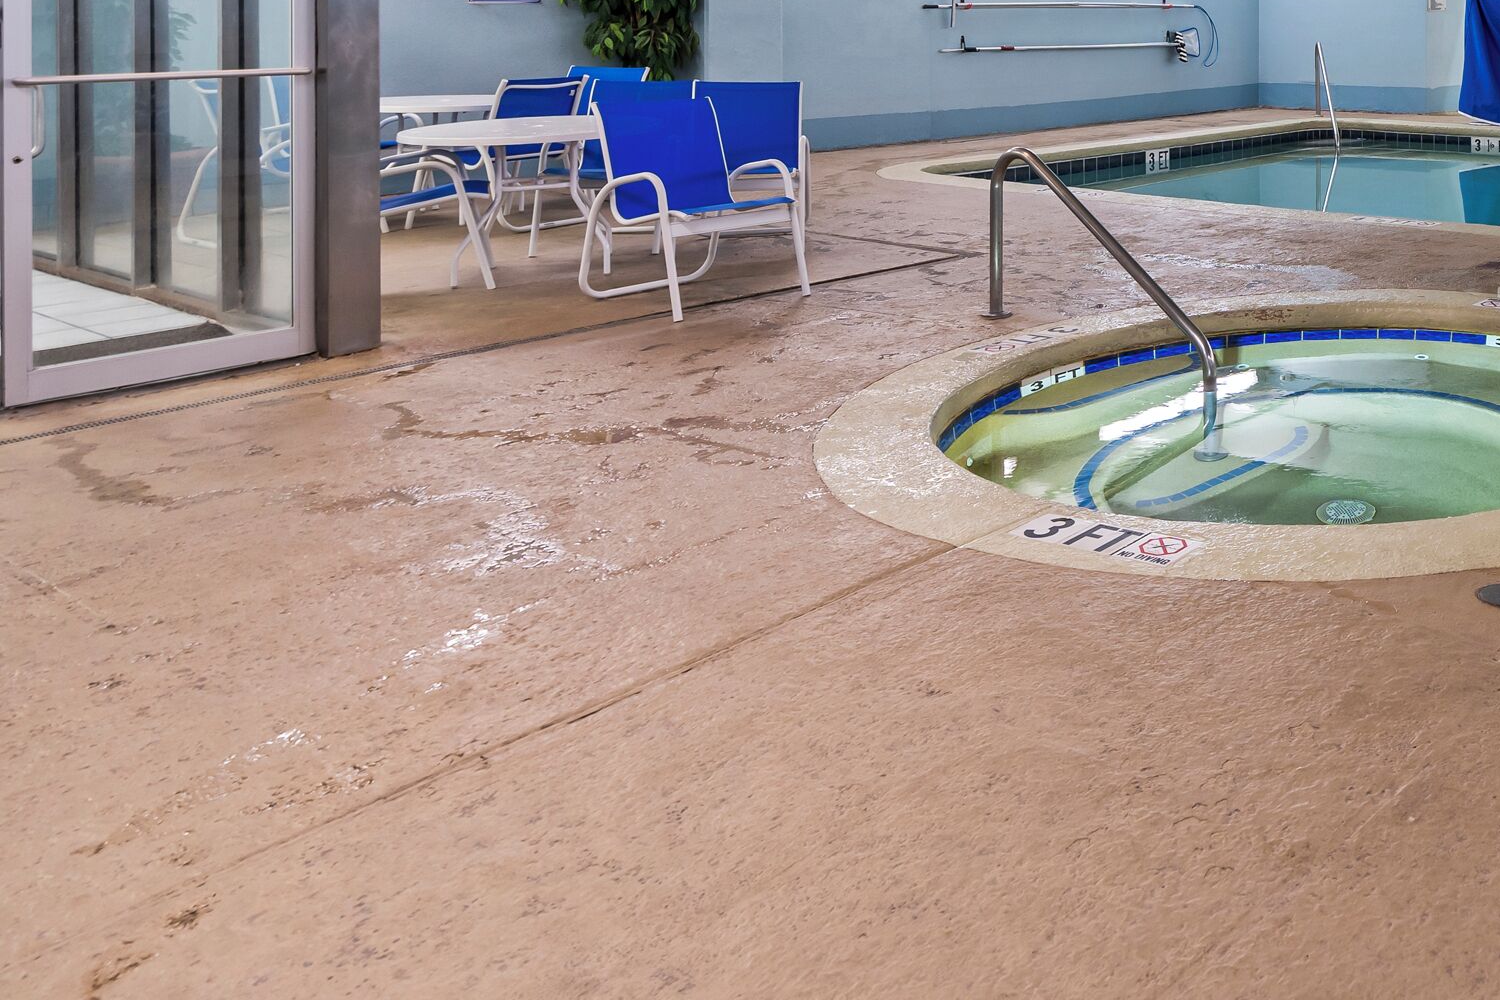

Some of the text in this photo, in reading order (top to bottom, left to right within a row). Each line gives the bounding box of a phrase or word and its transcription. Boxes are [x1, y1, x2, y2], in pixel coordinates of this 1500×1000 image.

[1159, 151, 1168, 165] FT
[1030, 367, 1081, 392] 3 FT
[1023, 517, 1144, 552] 3 FT
[1117, 550, 1170, 565] NO DIVING
